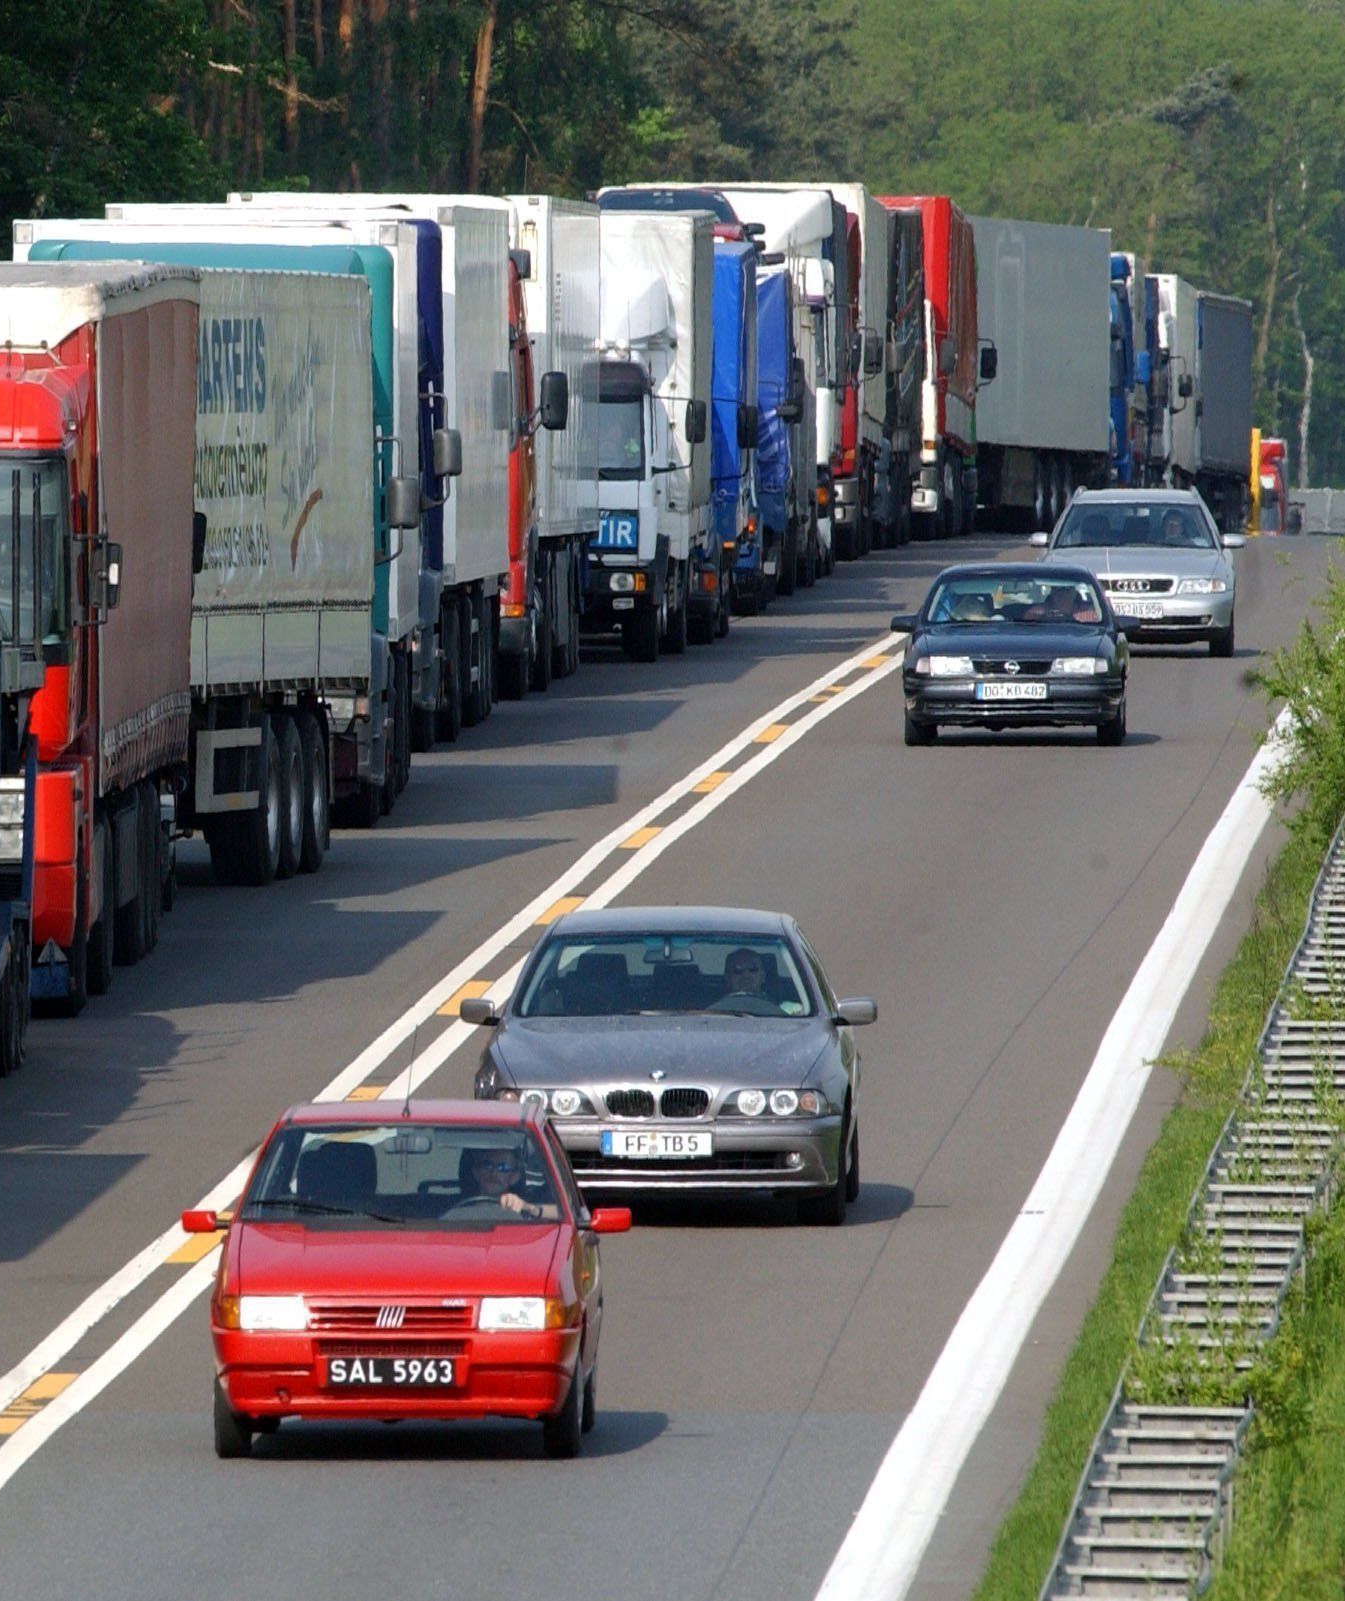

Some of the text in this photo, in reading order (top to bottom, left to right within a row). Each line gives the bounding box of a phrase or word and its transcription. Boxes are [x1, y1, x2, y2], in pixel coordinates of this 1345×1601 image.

[598, 519, 633, 545] TIR
[625, 1135, 648, 1152] FF
[661, 1135, 684, 1152] TB
[330, 1359, 453, 1384] SAL 5963
